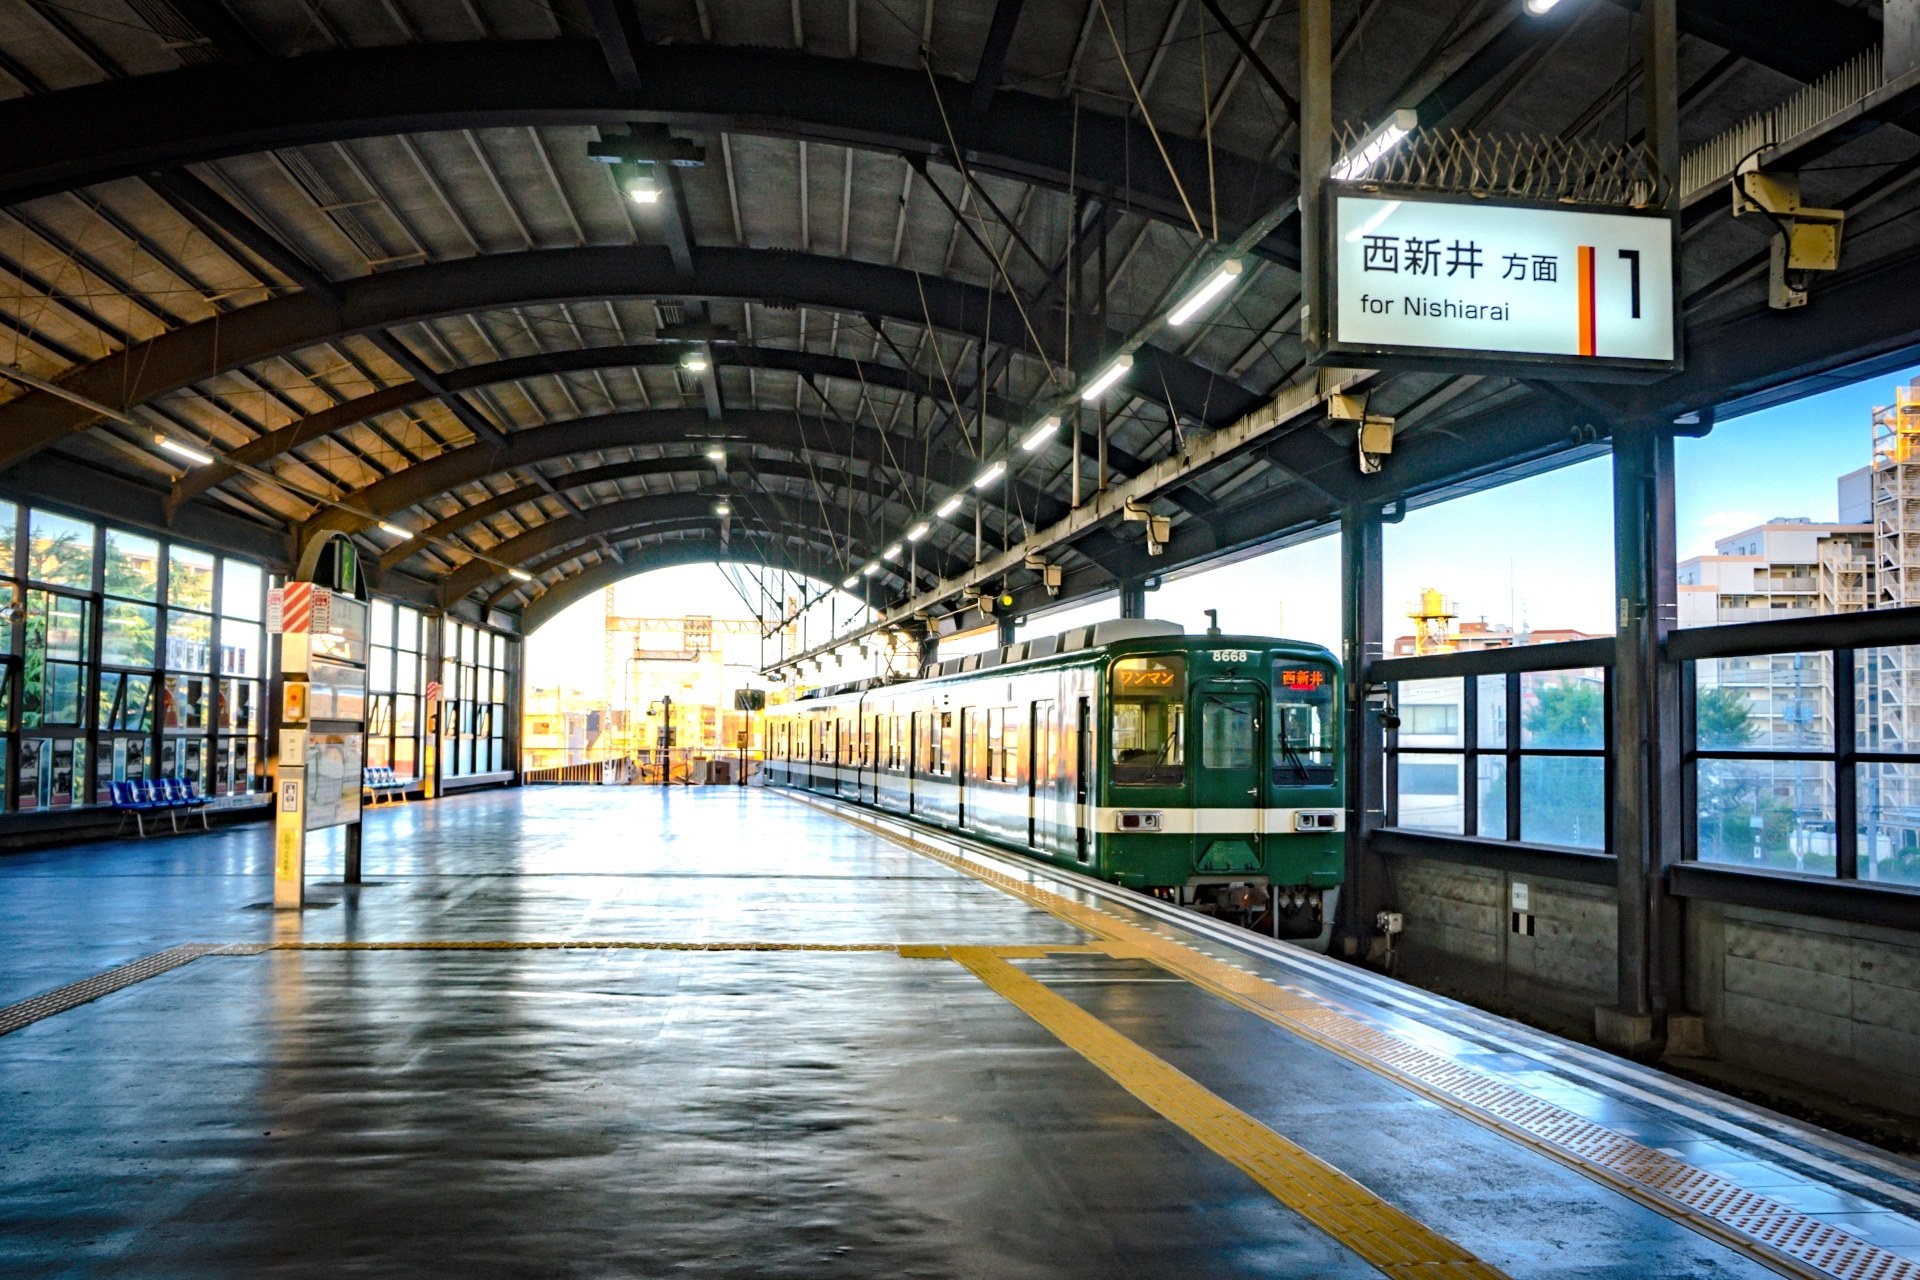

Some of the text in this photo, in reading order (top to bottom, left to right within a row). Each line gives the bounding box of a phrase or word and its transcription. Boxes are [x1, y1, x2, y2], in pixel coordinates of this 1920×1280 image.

[1362, 235, 1558, 283] 西新井 方面
[1618, 249, 1641, 319] 1
[1361, 294, 1509, 321] for Nishiarai
[1212, 651, 1247, 662] 8668
[1120, 671, 1175, 685] ワンマン
[1282, 670, 1323, 686] 西新井
